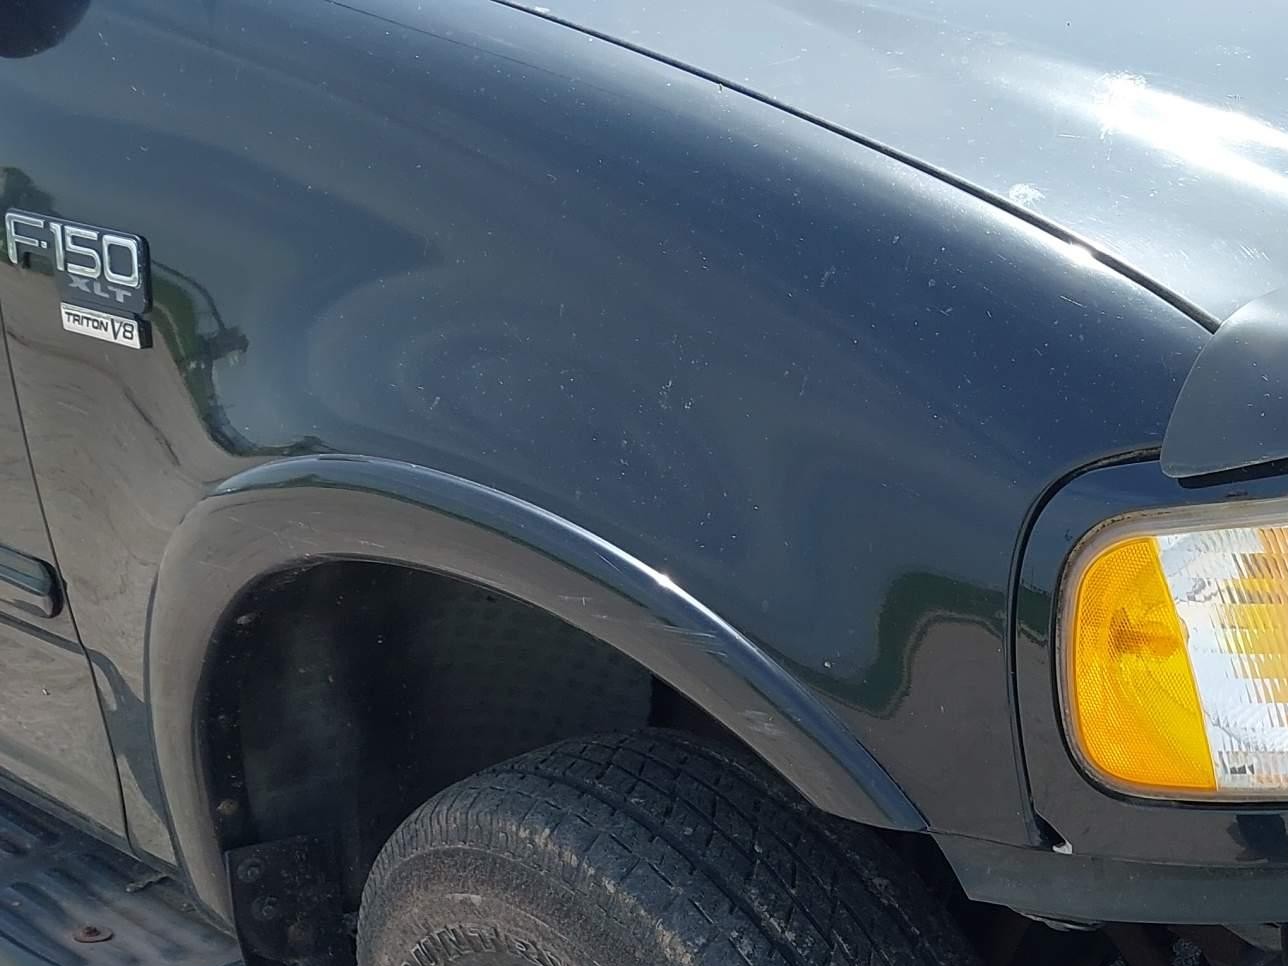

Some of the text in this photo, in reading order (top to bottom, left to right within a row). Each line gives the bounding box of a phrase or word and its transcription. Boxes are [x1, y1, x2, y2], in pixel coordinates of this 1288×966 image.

[67, 274, 132, 303] XLT
[65, 311, 135, 341] TRITON V8
